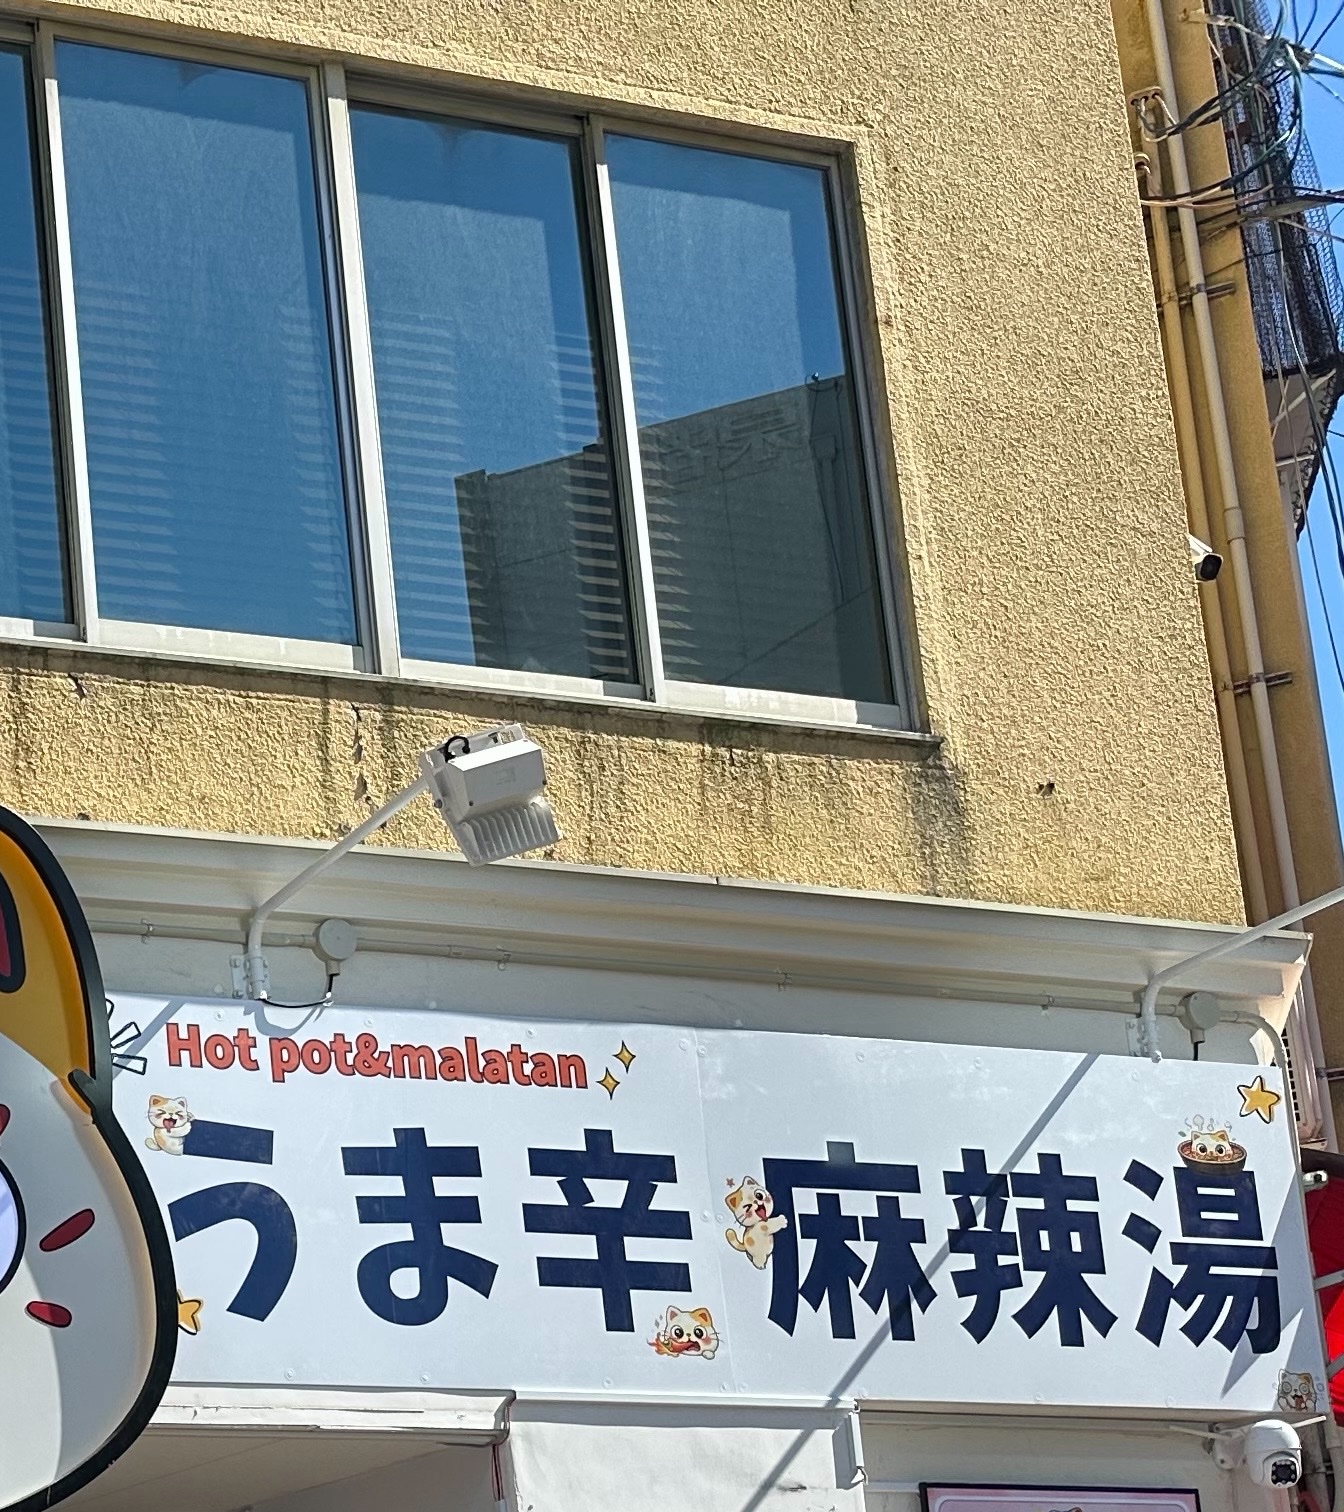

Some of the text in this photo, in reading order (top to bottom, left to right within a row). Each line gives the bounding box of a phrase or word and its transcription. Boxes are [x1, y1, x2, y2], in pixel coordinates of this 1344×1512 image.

[165, 1022, 588, 1091] Hot pot&malatan
[167, 1118, 1282, 1356] うま辛 麻辣湯
